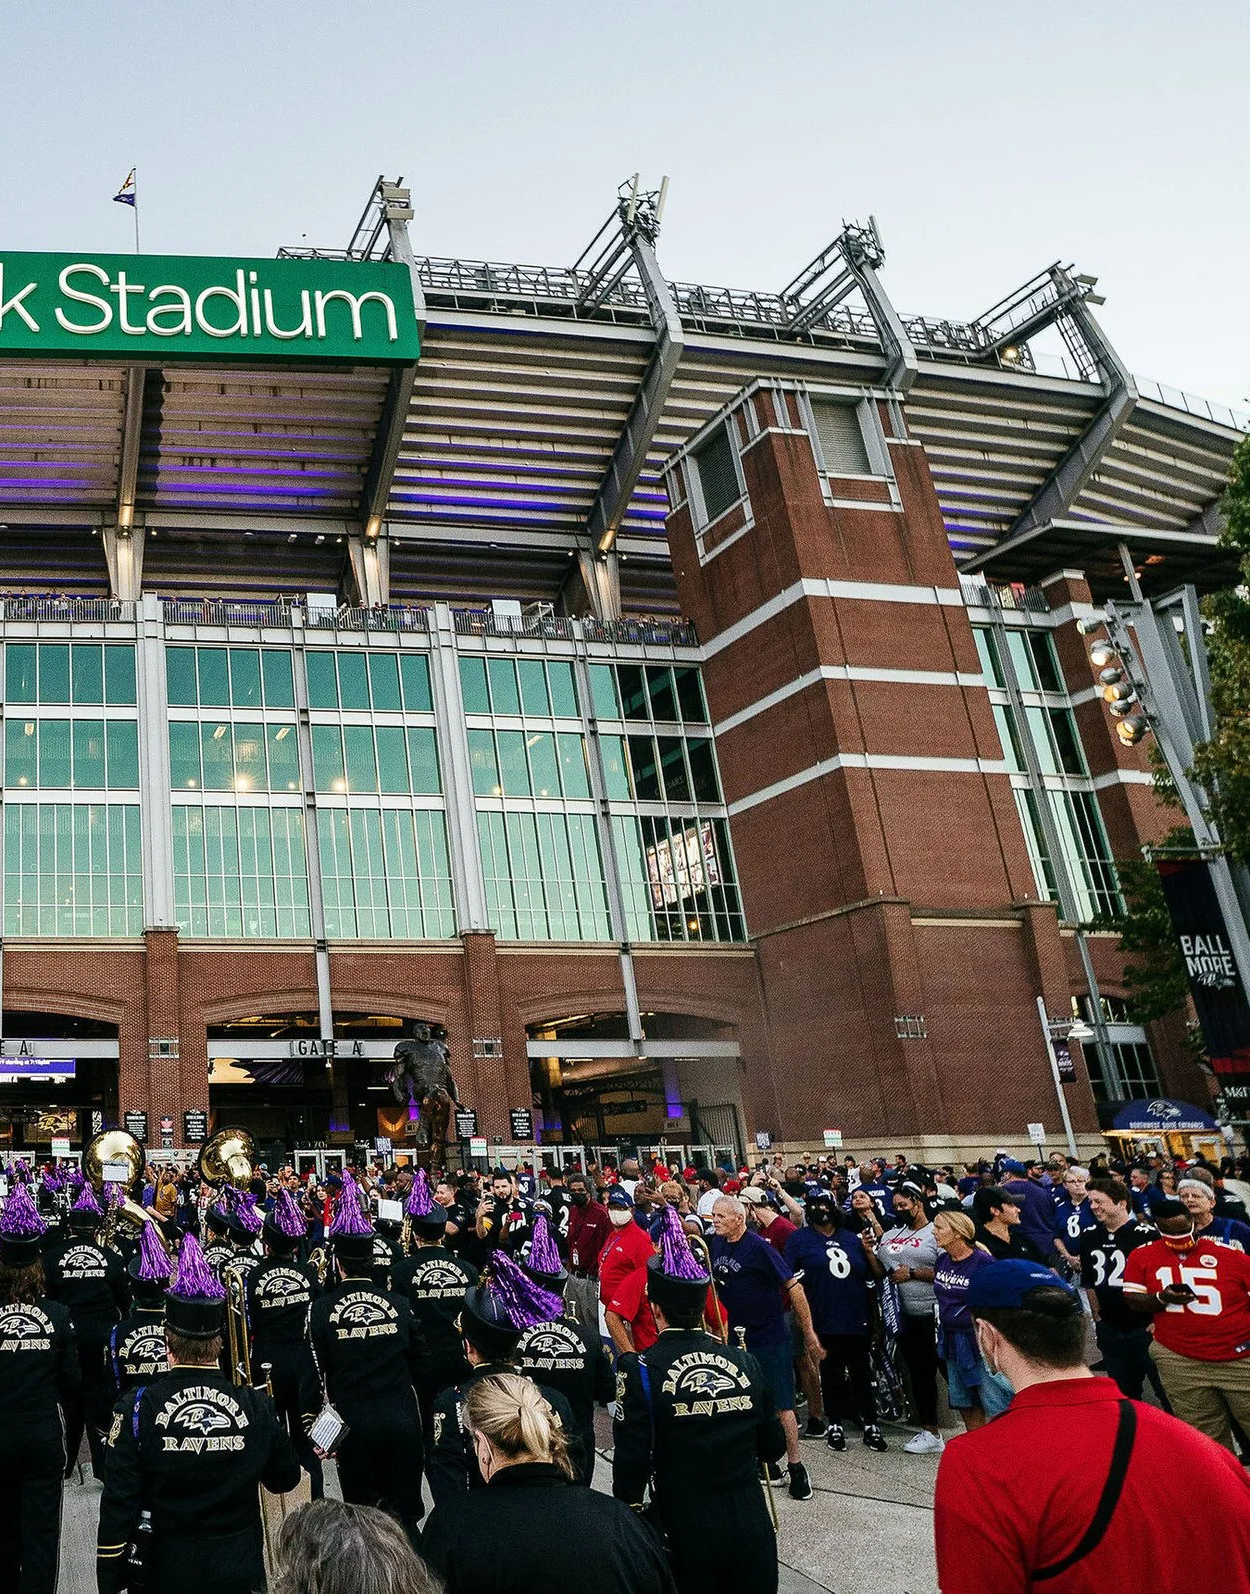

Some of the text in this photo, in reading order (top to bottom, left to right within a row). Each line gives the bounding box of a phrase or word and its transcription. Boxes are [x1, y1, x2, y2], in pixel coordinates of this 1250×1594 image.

[56, 263, 399, 342] Stadium
[1180, 934, 1230, 956] BALL
[1186, 956, 1236, 977] MORE
[19, 1040, 29, 1055] A
[298, 1040, 361, 1056] GATE A
[1066, 1214, 1081, 1238] 8
[59, 1245, 108, 1268] BALTIMORE
[825, 1247, 851, 1279] 8
[62, 1269, 105, 1279] RAVENS
[412, 1259, 469, 1286] BALTIMORE
[936, 1271, 970, 1287] RAVENS
[1090, 1249, 1126, 1288] 32
[254, 1267, 311, 1296] BALTIMORE
[1155, 1266, 1223, 1316] 15
[260, 1292, 310, 1309] RAVENS
[417, 1287, 467, 1299] RAVENS
[329, 1291, 399, 1324] BALTIMORE
[119, 1325, 165, 1359] BALTIM
[336, 1323, 398, 1340] RAVENS
[516, 1322, 587, 1354] BALTIMORE
[126, 1363, 170, 1376] RAVE
[521, 1356, 585, 1371] RAVENS
[662, 1352, 751, 1396] BALTIMORE
[155, 1386, 250, 1430] BALTIMORE
[672, 1396, 753, 1418] RAVENS
[162, 1436, 246, 1455] RAVENS
